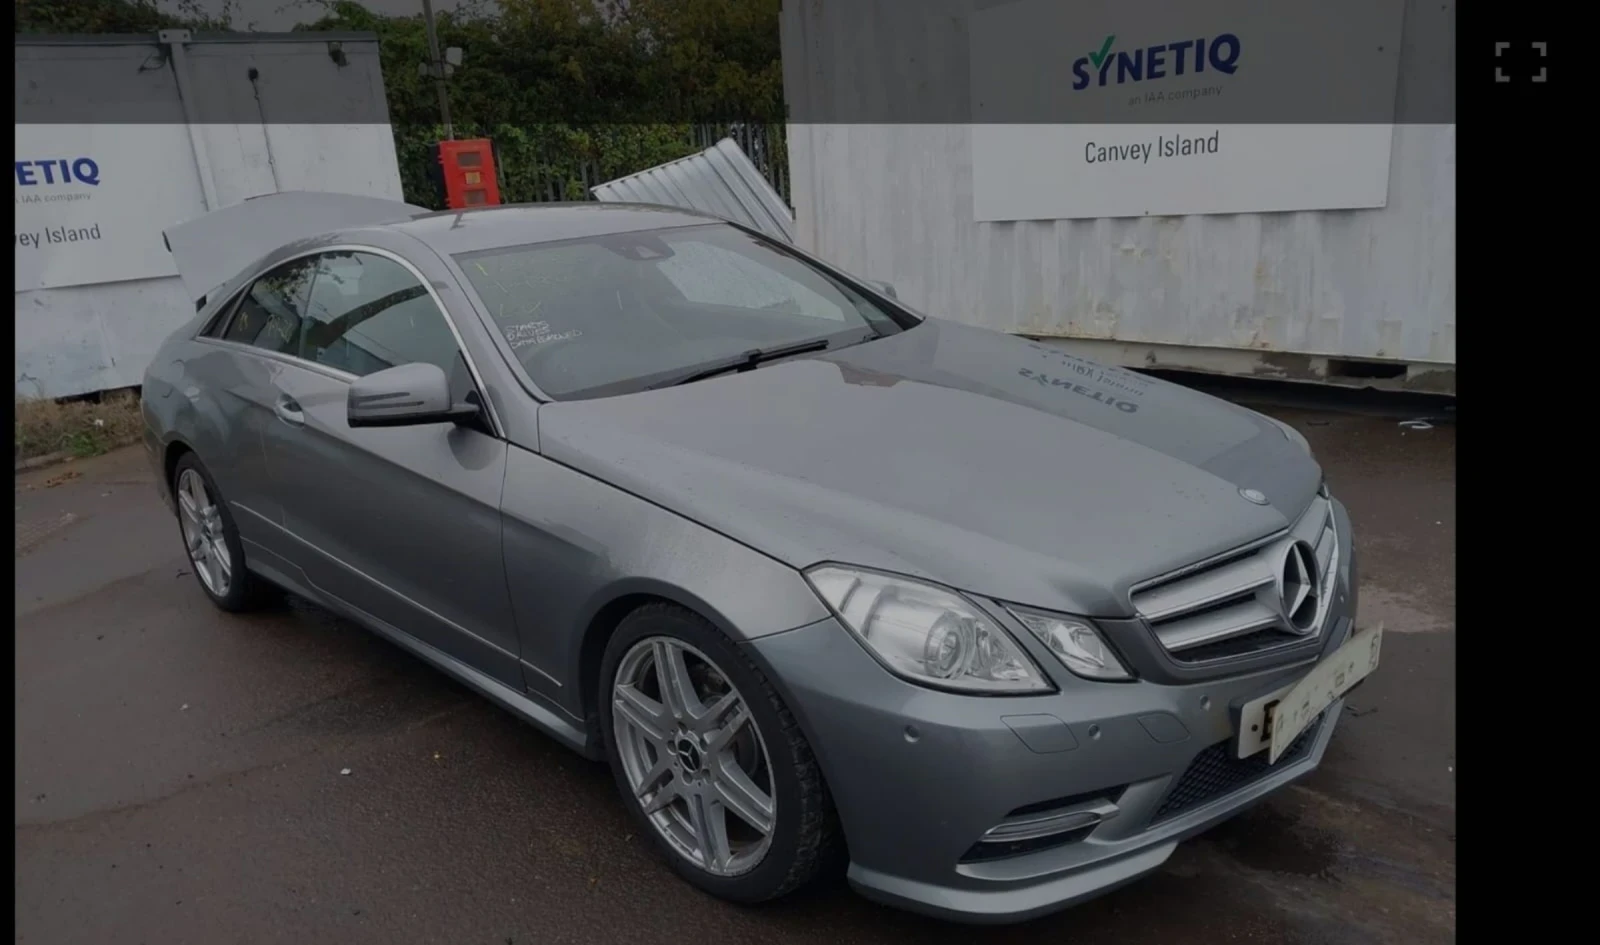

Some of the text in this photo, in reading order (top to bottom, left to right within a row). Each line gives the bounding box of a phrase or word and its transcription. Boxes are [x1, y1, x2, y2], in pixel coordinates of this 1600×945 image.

[1072, 33, 1241, 90] SYNETIQ
[1128, 86, 1223, 106] an IAA company
[1085, 130, 1219, 164] Canvey Island
[21, 194, 41, 204] IAA
[44, 192, 91, 202] company
[45, 223, 101, 244] Island
